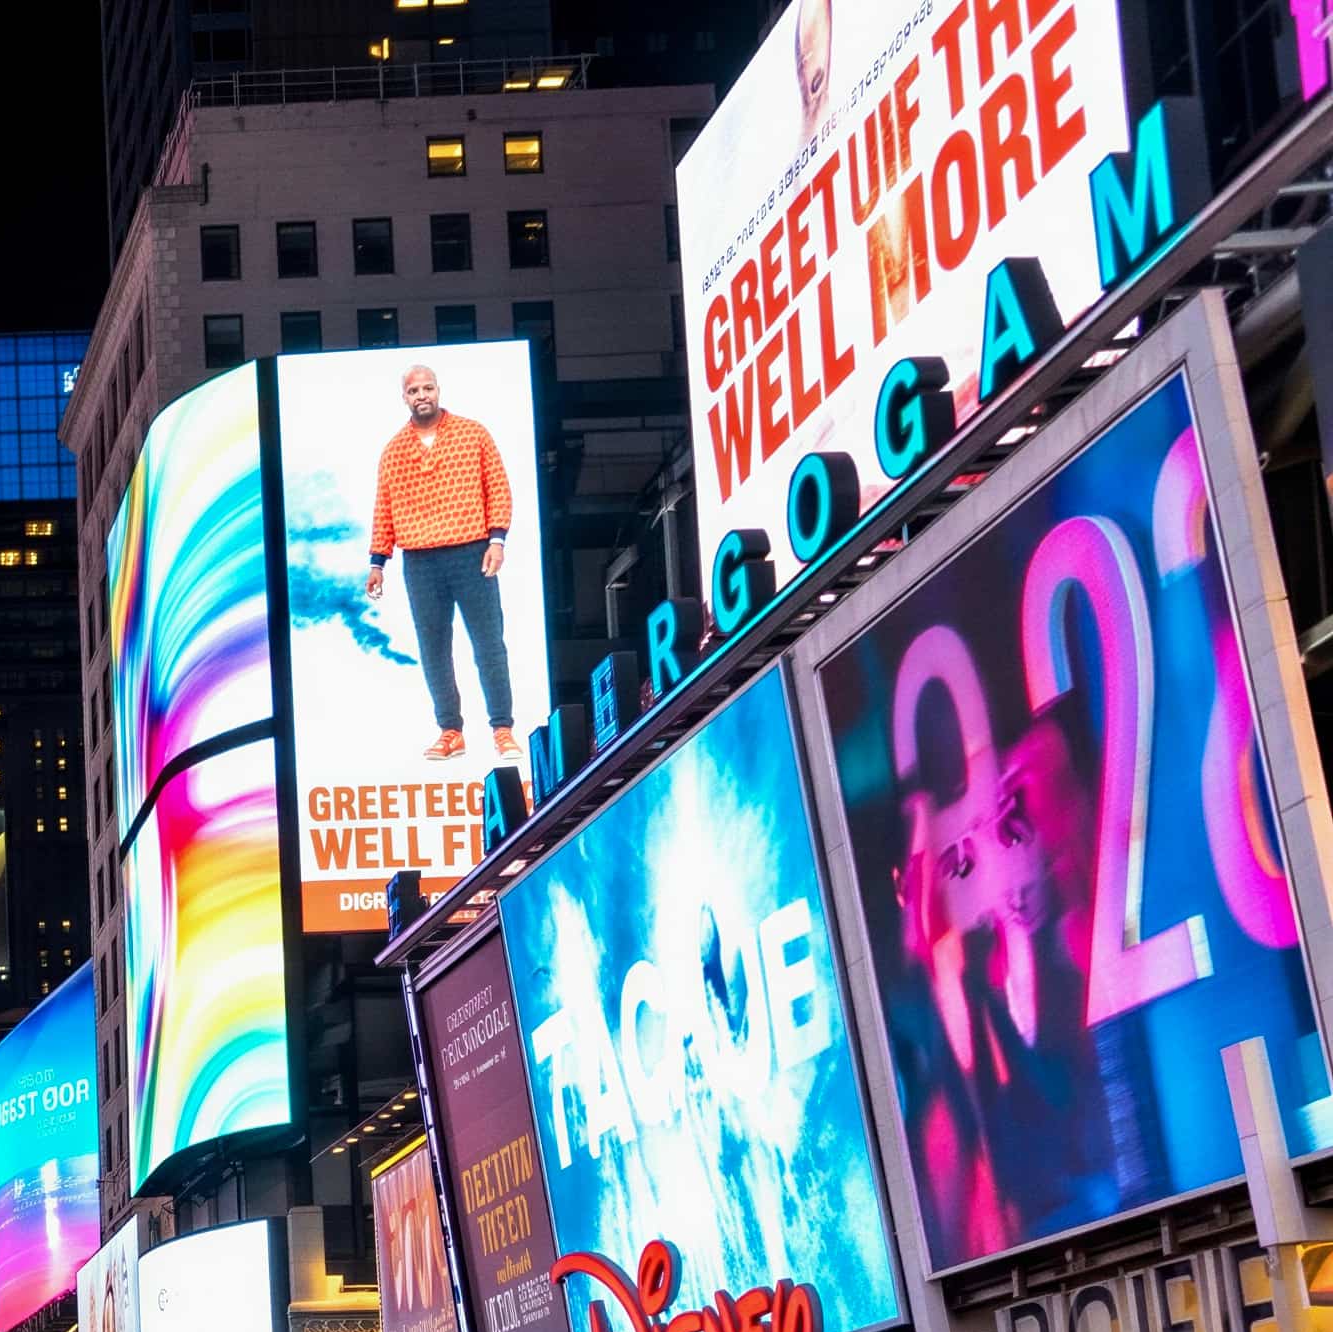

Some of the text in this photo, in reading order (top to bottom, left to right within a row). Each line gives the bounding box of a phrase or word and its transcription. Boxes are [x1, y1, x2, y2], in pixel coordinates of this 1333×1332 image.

[703, 149, 841, 393] GREET
[707, 271, 856, 505] WELL
[866, 3, 1087, 348] MORE
[309, 825, 432, 871] WELL
